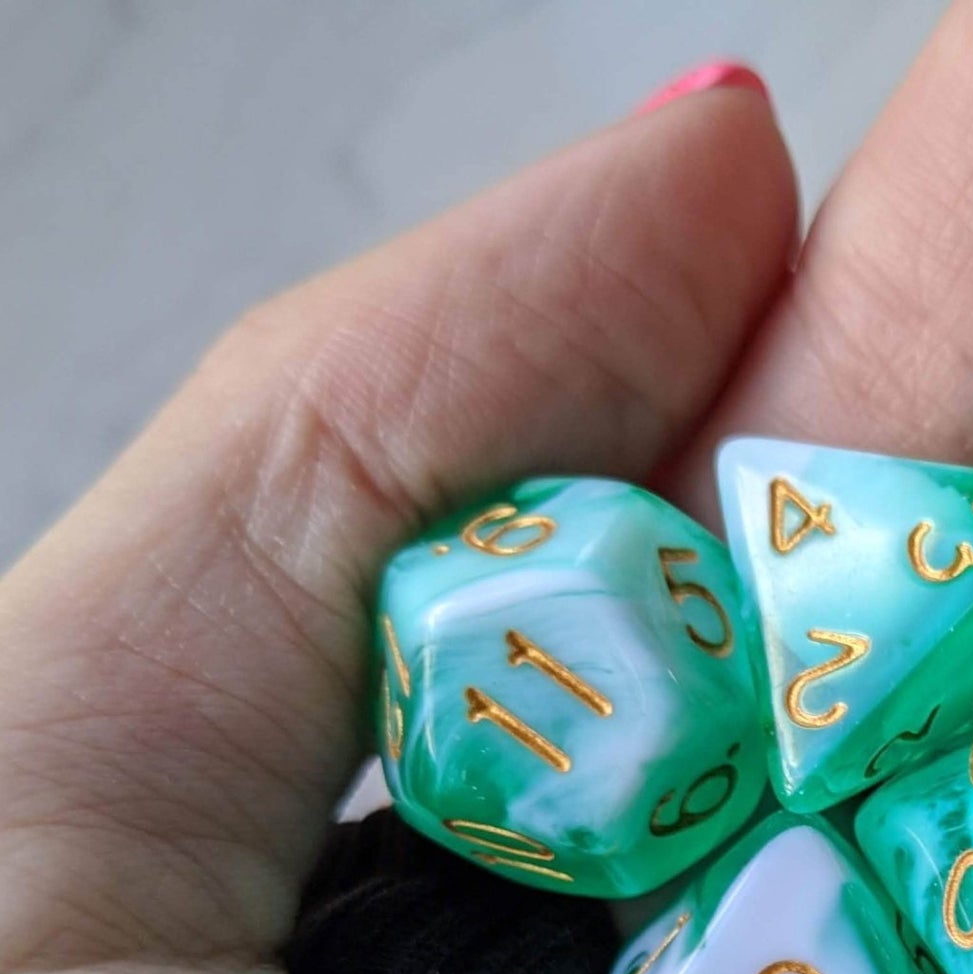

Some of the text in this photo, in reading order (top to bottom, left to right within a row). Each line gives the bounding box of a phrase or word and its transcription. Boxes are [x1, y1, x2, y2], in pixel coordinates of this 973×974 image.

[769, 476, 836, 555] 4
[659, 547, 735, 659] 5
[464, 629, 614, 773] 11
[784, 627, 871, 730] 2
[442, 819, 576, 883] 10
